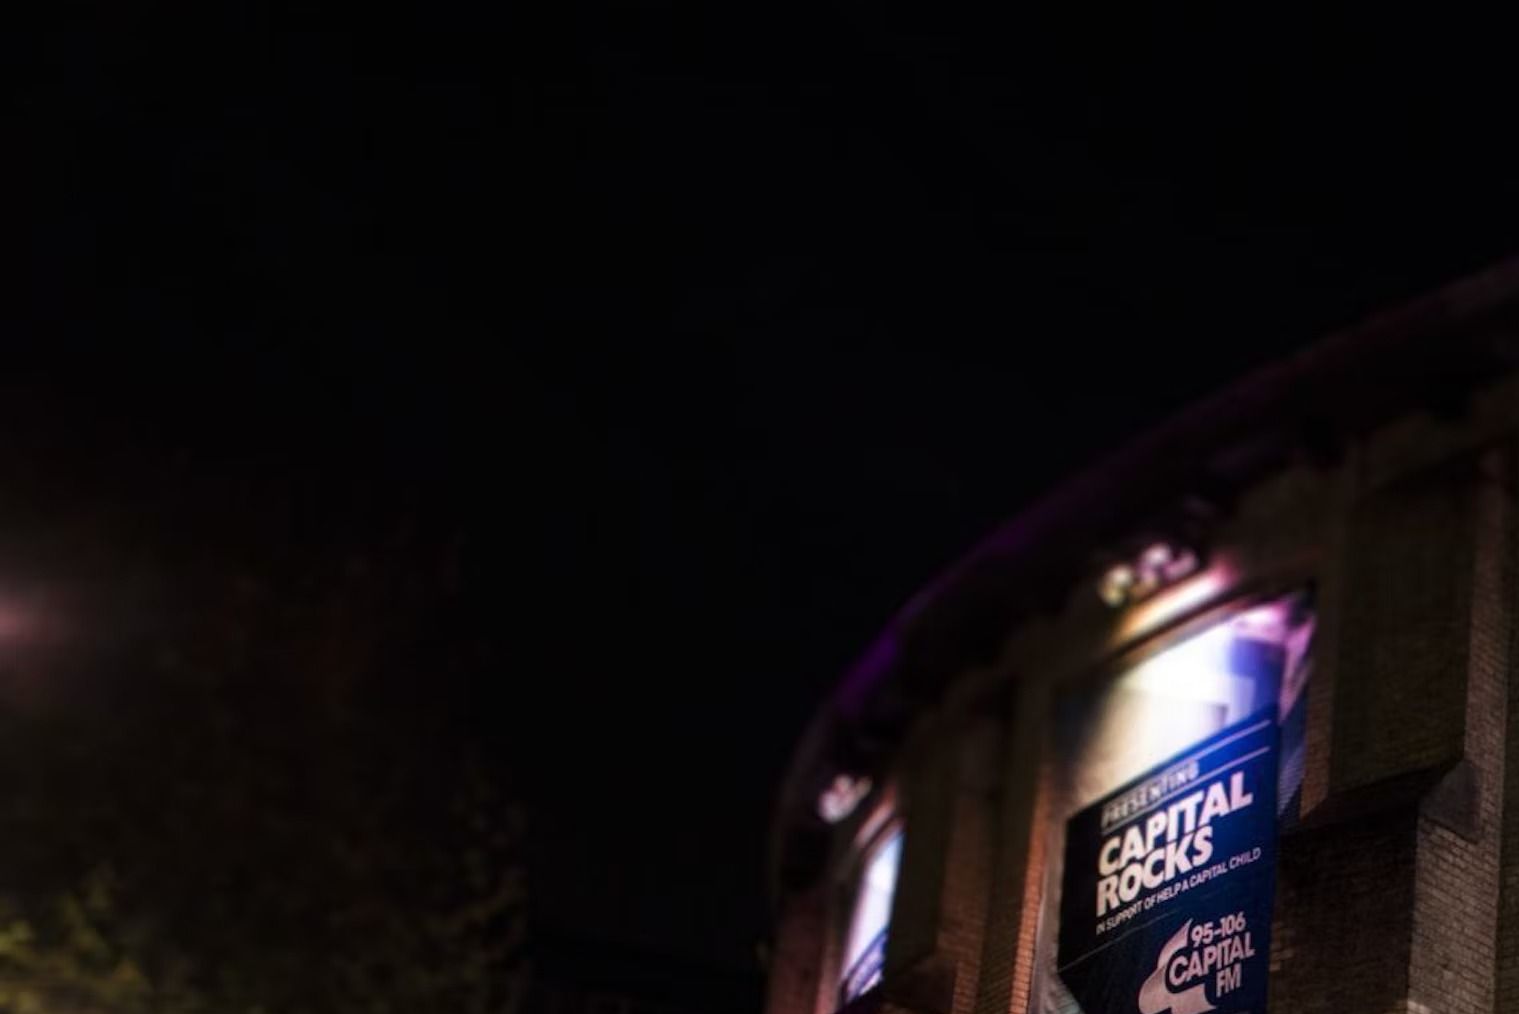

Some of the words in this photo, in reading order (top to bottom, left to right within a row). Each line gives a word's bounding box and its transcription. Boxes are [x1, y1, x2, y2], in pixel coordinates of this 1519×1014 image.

[1098, 771, 1253, 875] CAPITAL
[1096, 825, 1213, 917] ROCKS
[1096, 923, 1105, 936] IN
[1107, 902, 1142, 930] SUPPORT
[1144, 895, 1155, 910] OF
[1157, 883, 1180, 902] HELP
[1180, 880, 1189, 892] A
[1189, 862, 1227, 887] CAPITAL
[1230, 847, 1261, 870] CHILD
[1169, 932, 1255, 986] CAPITAL
[1191, 911, 1246, 947] 95-106
[1216, 964, 1242, 997] FM
